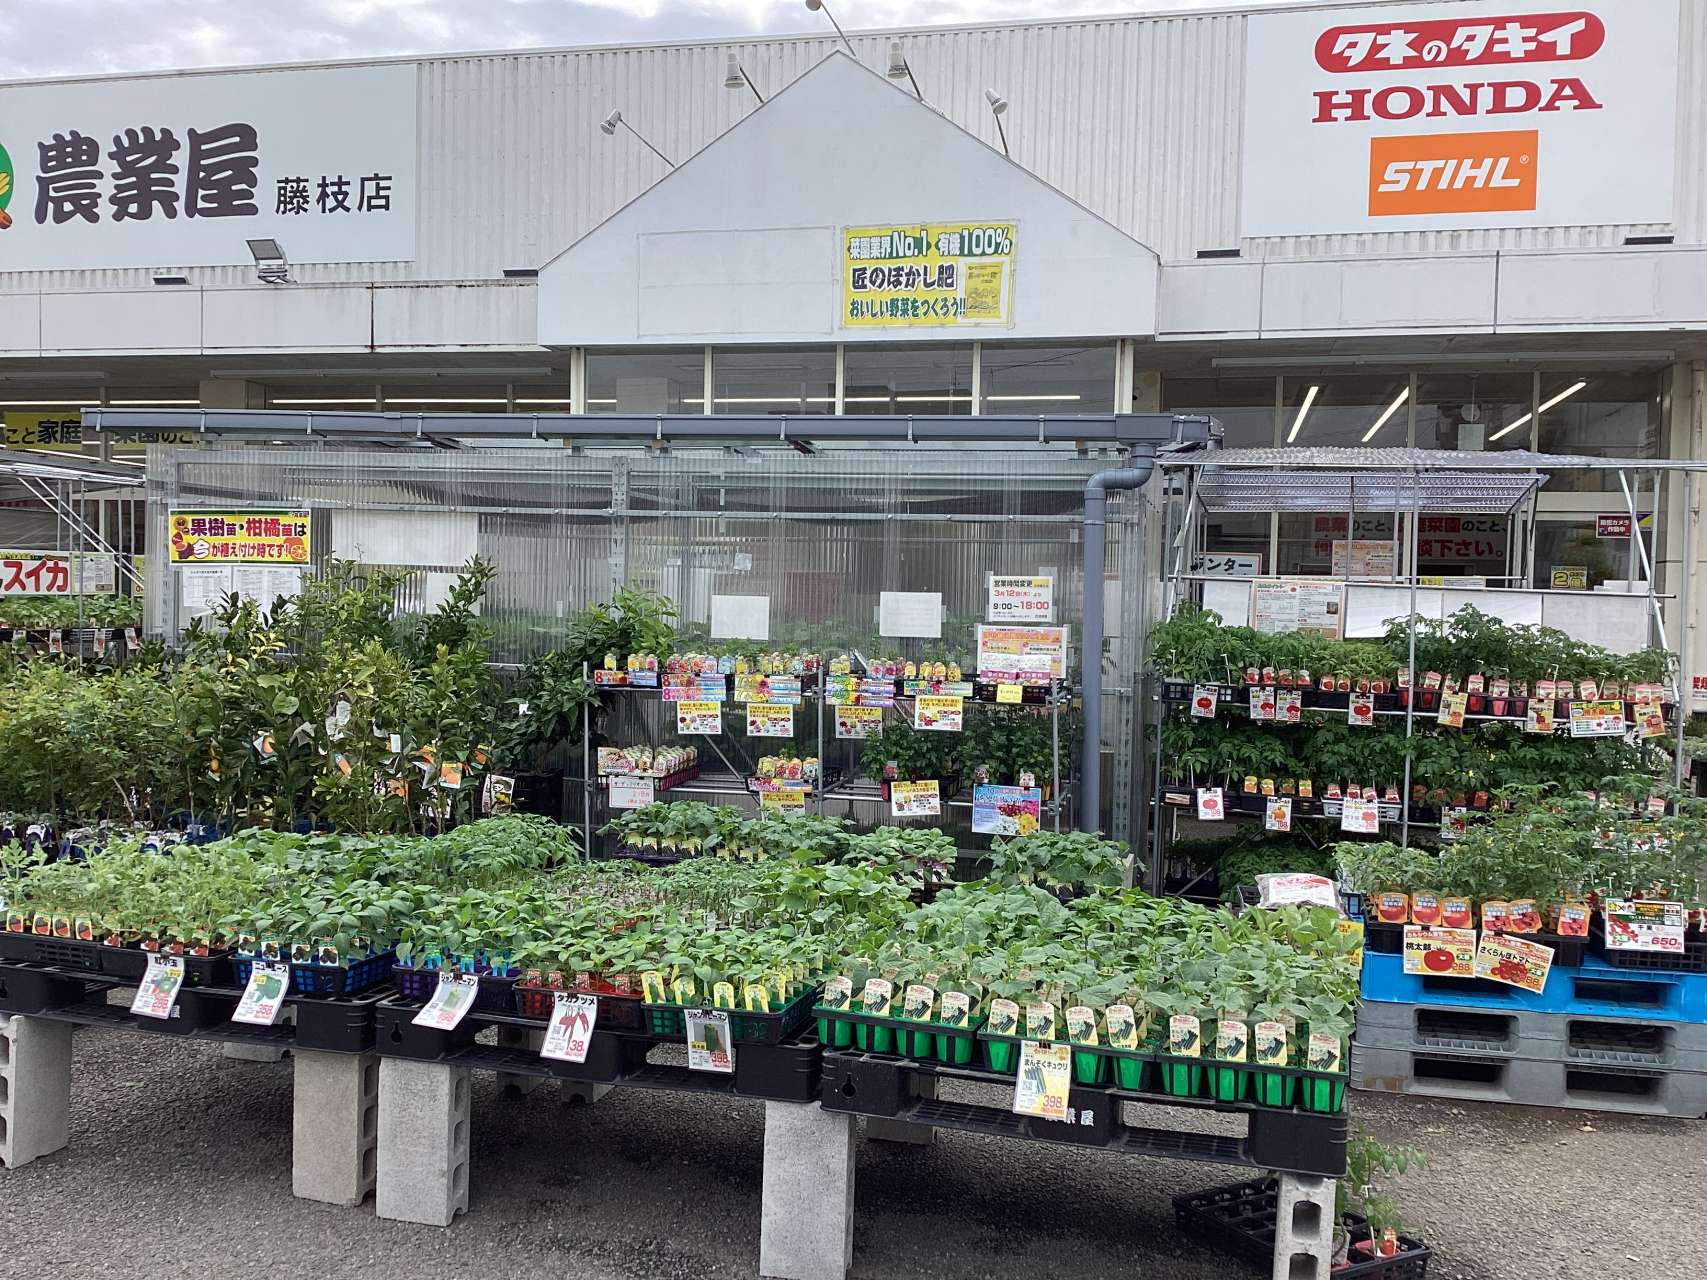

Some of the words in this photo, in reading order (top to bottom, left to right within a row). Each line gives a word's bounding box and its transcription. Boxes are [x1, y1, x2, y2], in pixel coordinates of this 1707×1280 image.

[1332, 17, 1586, 68] タネのタキイ
[1311, 77, 1603, 124] HONDA
[34, 122, 260, 225] 農業屋
[275, 173, 393, 215] 藤枝店
[937, 227, 1011, 257] 有機100%
[852, 263, 955, 291] 匠のぼかし肥
[190, 517, 307, 539] 果樹苗・柑橘苗は
[1405, 942, 1431, 951] 桃太郎
[1480, 946, 1531, 964] さくらんぼトマト
[557, 994, 596, 1006] タカノツメ
[1024, 1059, 1068, 1070] まんぞくキュウリ
[1042, 1095, 1063, 1108] 398
